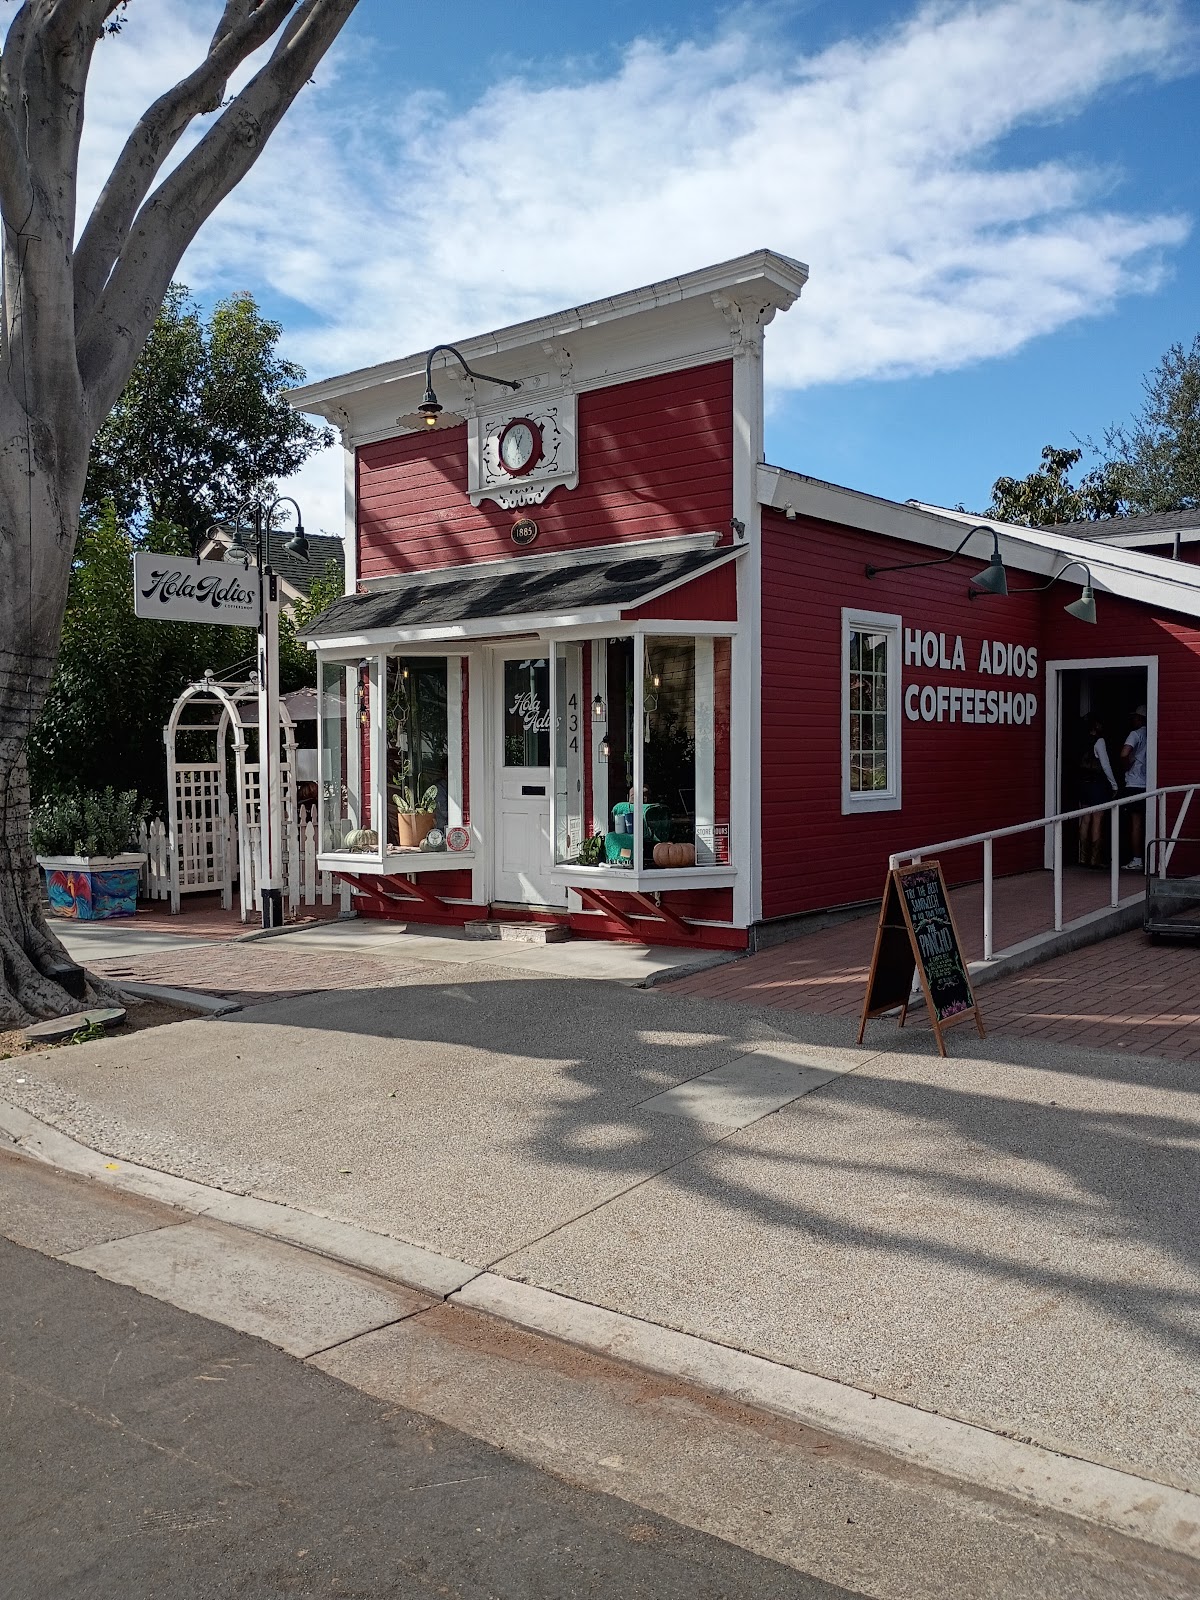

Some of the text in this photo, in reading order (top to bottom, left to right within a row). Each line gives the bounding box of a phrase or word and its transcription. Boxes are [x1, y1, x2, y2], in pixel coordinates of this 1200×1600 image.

[517, 527, 532, 537] 1885
[141, 569, 257, 609] Hola Adios
[905, 627, 1038, 679] HOLA ADIOS
[509, 692, 541, 717] Hola
[905, 684, 1038, 725] COFFEESHOP
[522, 708, 562, 734] Adis
[919, 927, 953, 958] PANCHO
